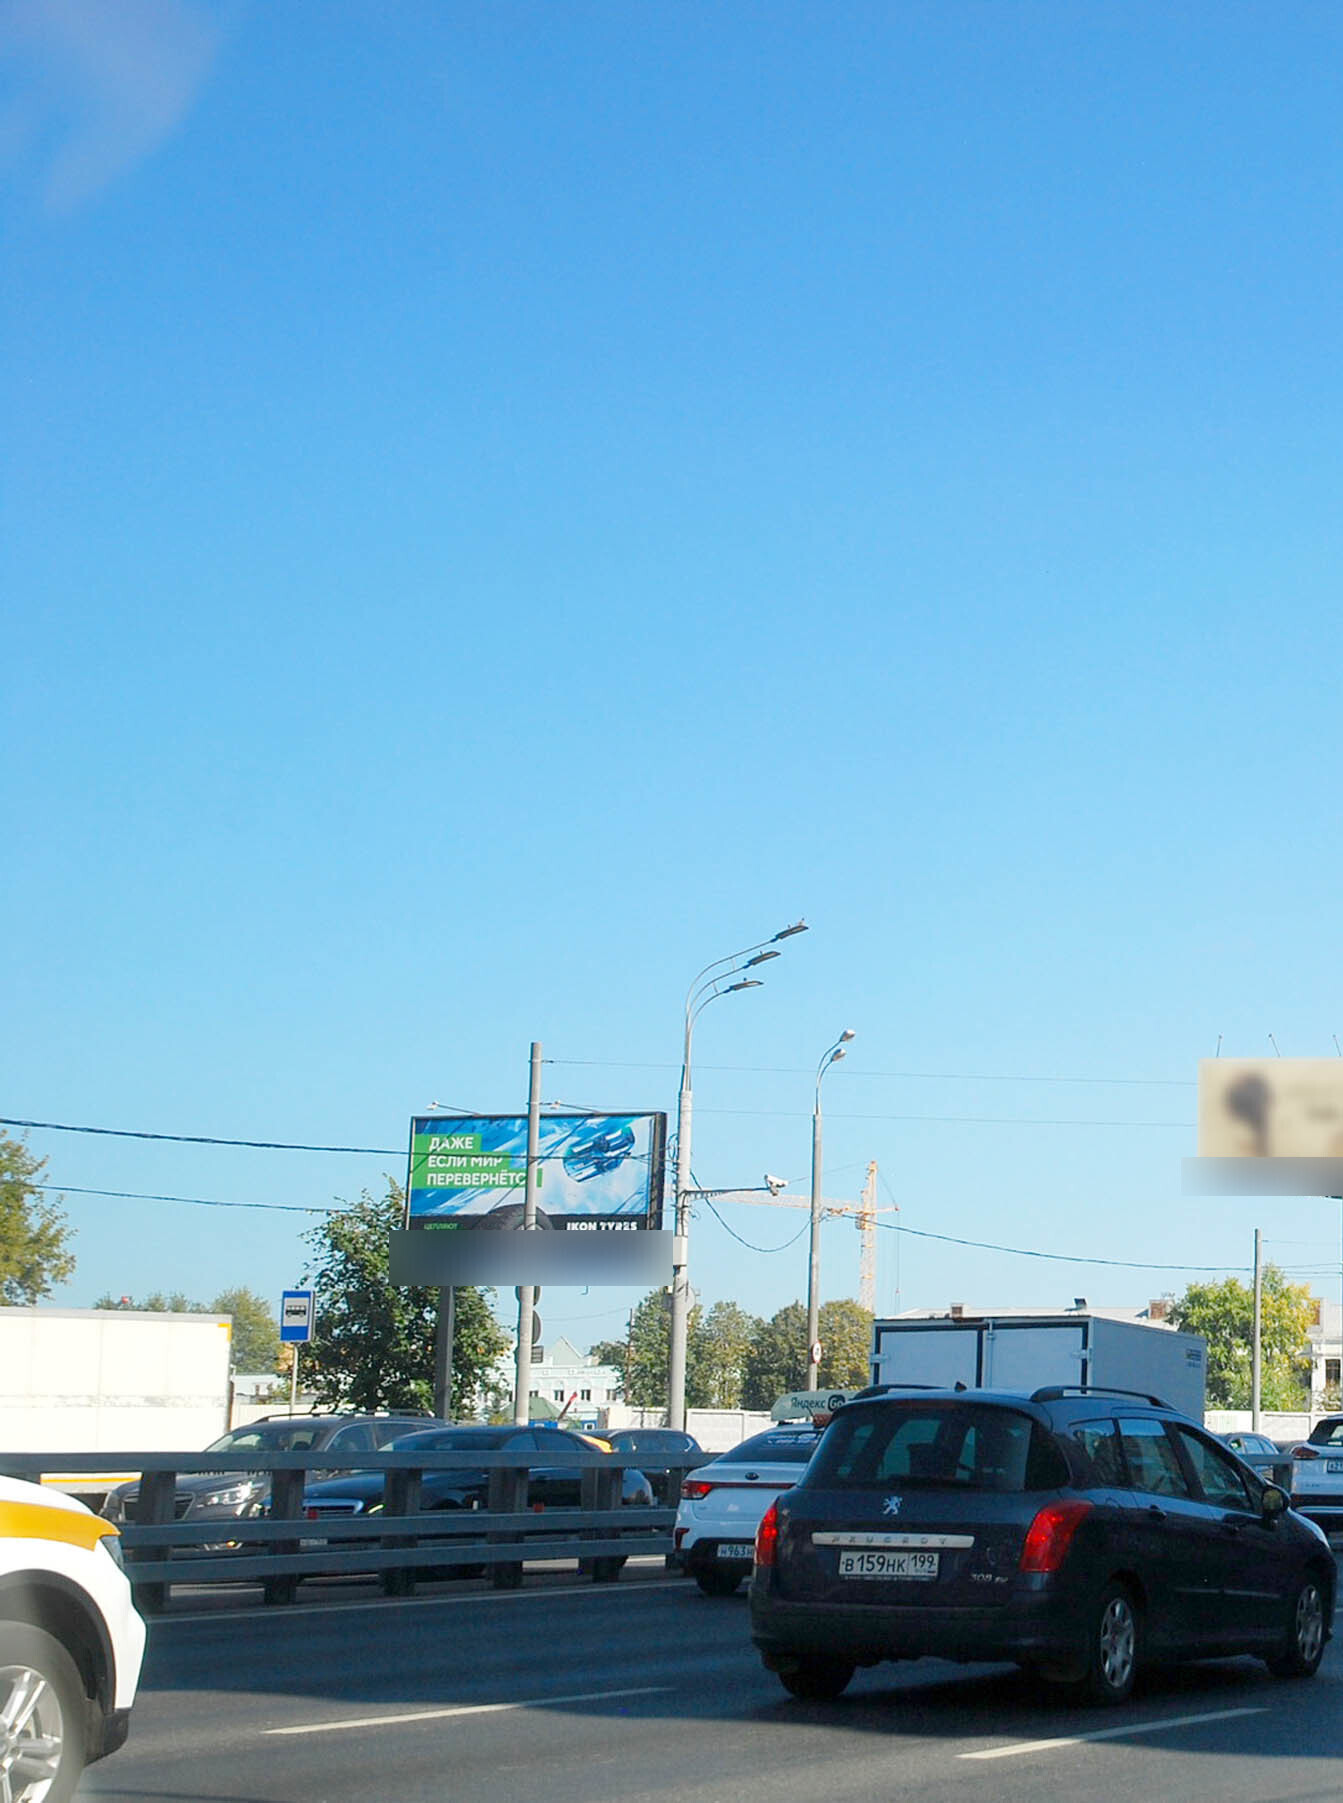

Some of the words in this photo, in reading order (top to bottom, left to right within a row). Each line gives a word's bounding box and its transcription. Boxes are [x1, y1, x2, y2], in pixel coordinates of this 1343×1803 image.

[429, 1136, 474, 1151] ДАЖЕ
[427, 1155, 467, 1168] ЕСЛИ
[470, 1155, 503, 1168] МИР
[427, 1169, 527, 1185] ПЕРЕВЕРНЁТС
[566, 1221, 597, 1231] IKON
[600, 1221, 638, 1231] TYRES
[790, 1397, 826, 1409] Яндекс
